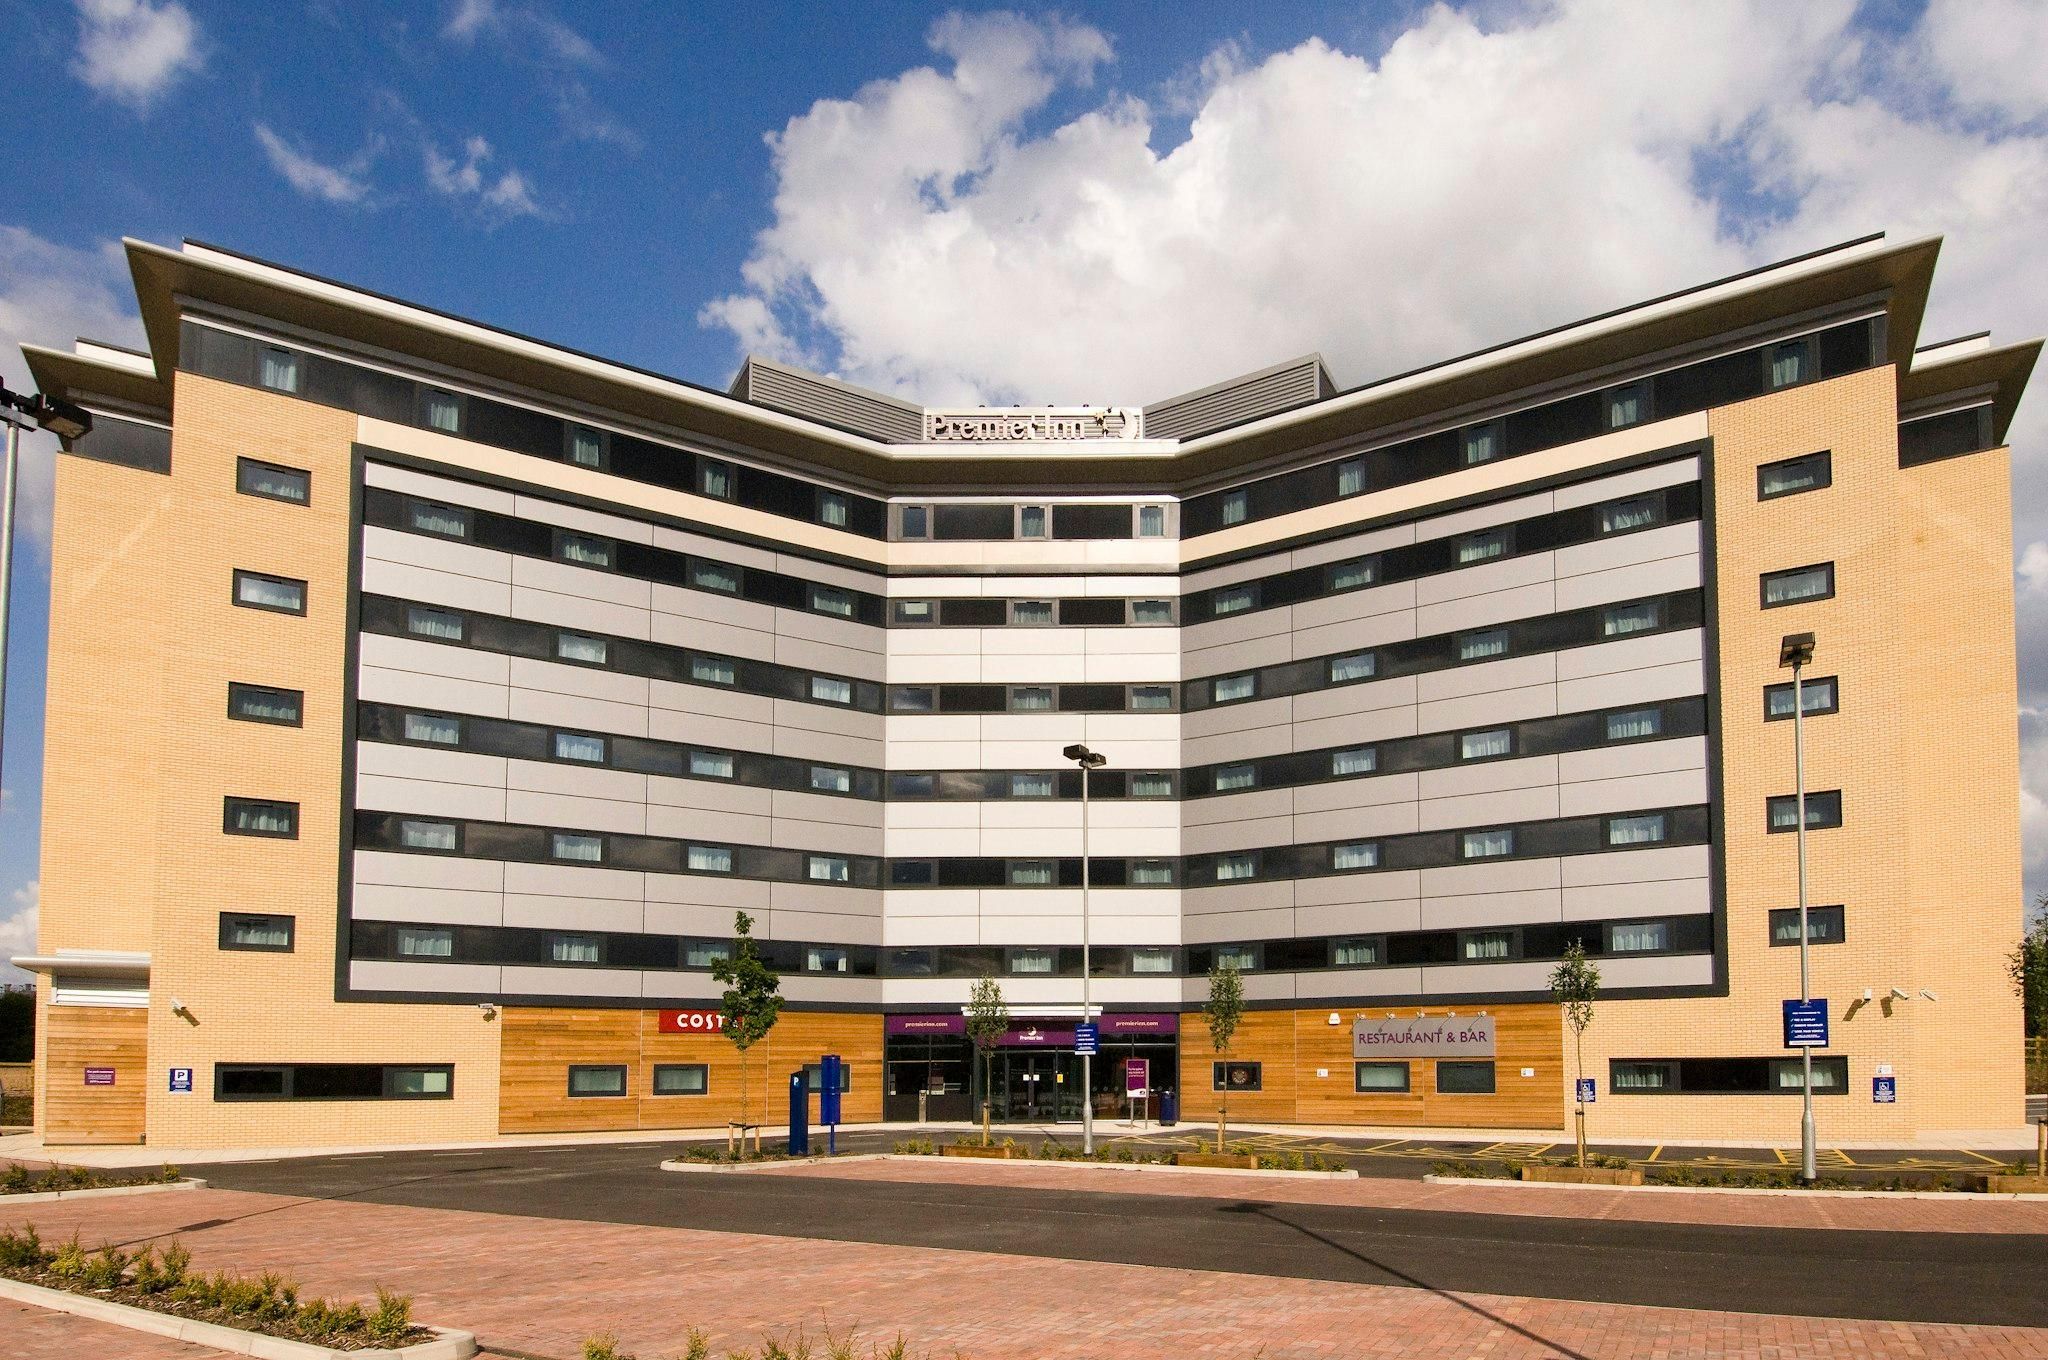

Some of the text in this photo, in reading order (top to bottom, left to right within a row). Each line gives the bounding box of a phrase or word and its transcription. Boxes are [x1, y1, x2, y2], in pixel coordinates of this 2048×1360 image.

[931, 414, 1085, 440] Premier Inn
[677, 1013, 738, 1030] COST
[1358, 1031, 1488, 1044] RESTAURANT & BAR
[177, 1071, 185, 1079] P
[793, 1076, 799, 1086] P
